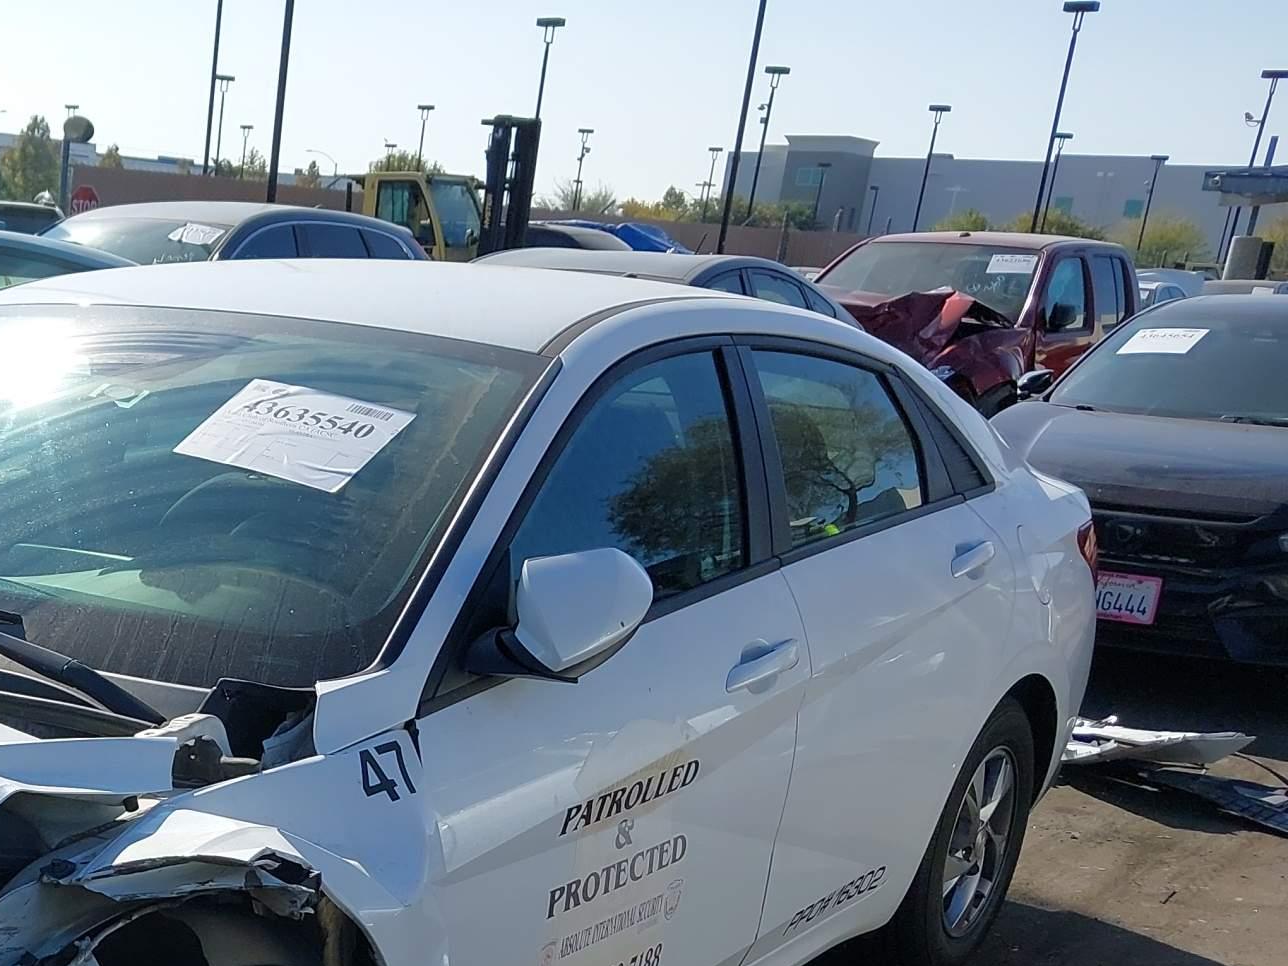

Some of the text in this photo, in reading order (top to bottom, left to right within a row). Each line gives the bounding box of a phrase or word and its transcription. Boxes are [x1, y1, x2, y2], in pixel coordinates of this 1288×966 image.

[243, 398, 376, 439] 43635540
[359, 740, 417, 802] 47
[558, 759, 700, 838] PATROLLED
[615, 818, 635, 850] &
[546, 834, 688, 920] PROTECTED
